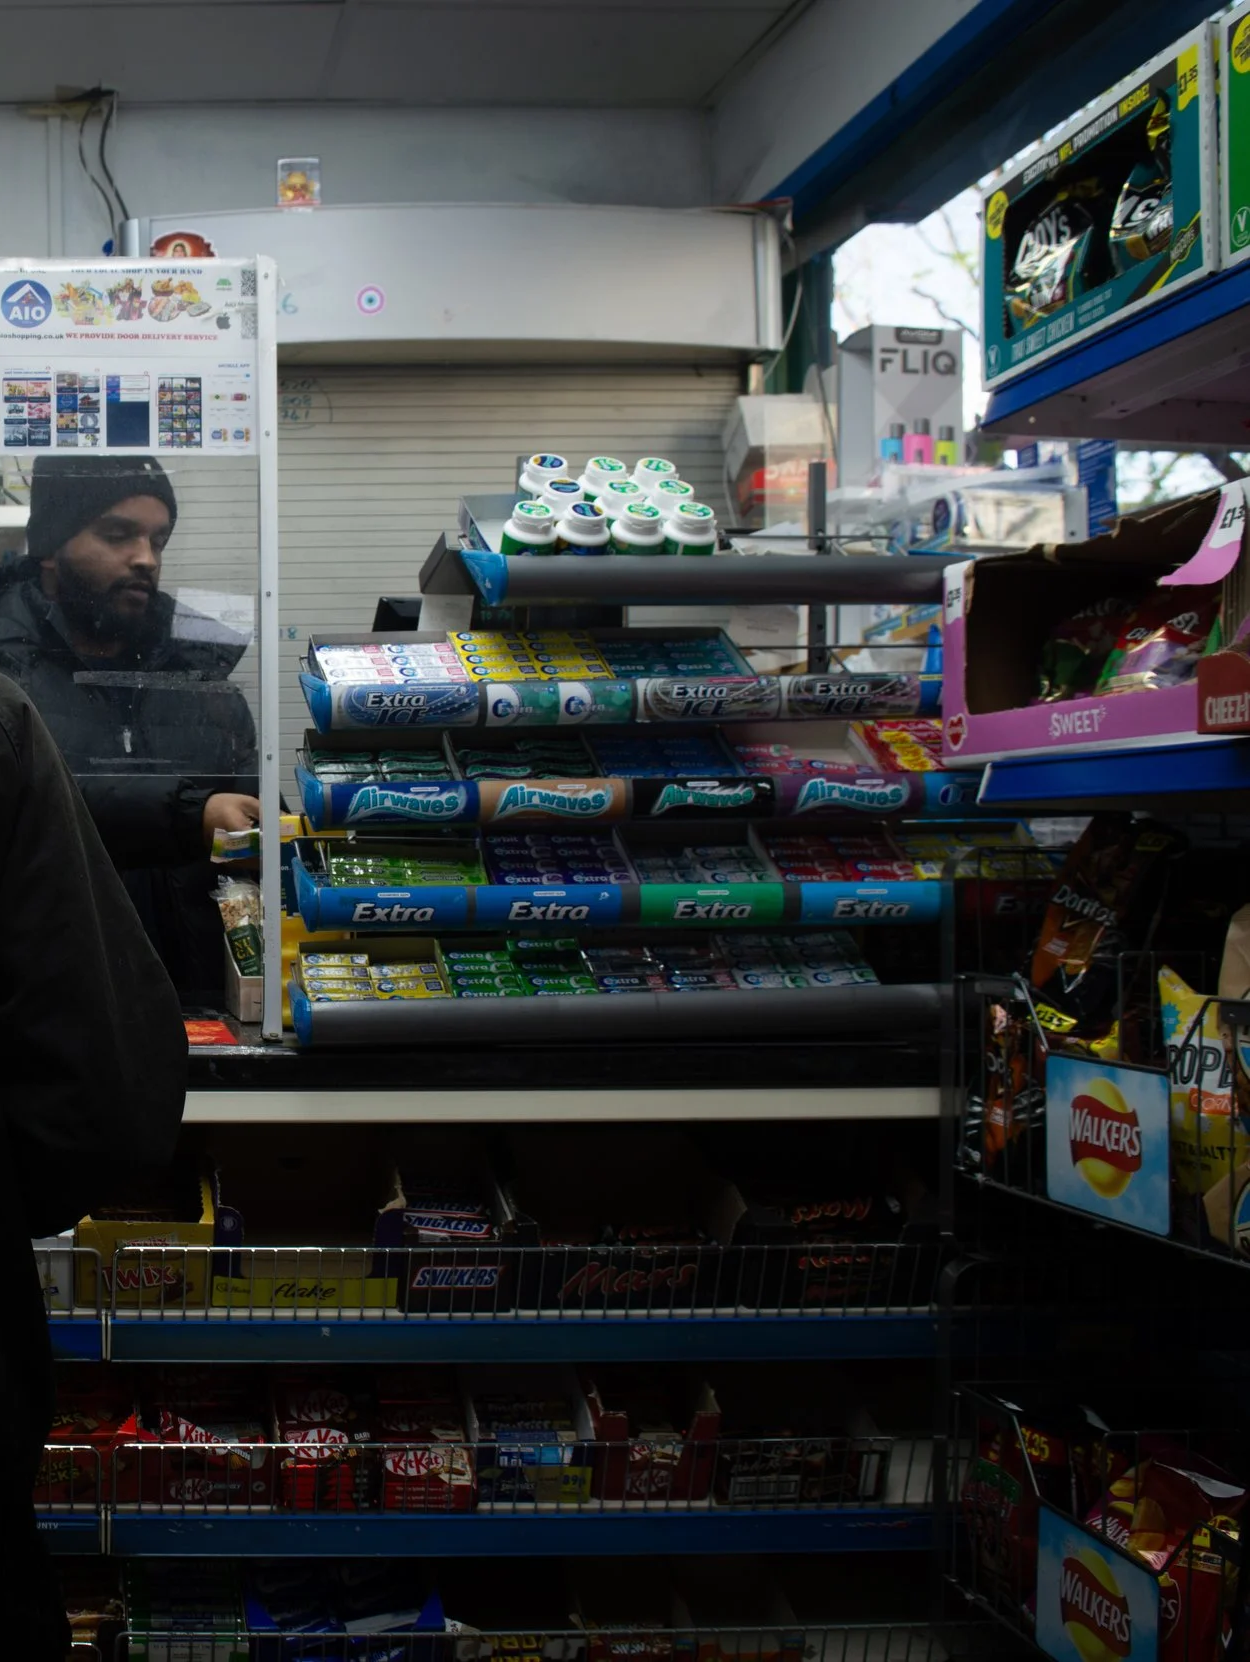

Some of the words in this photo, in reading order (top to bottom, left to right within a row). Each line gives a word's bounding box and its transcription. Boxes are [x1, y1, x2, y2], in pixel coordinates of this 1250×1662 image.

[8, 306, 47, 322] AIO
[65, 332, 77, 340] WE
[79, 332, 116, 340] PROVIDE
[117, 333, 140, 341] DOOR
[141, 333, 183, 341] DELIVERY
[183, 334, 219, 342] SERVICE
[879, 348, 958, 376] FLIQ
[365, 691, 428, 709] Extra
[671, 684, 728, 700] Extra
[373, 705, 430, 726] ICE
[1050, 708, 1102, 738] SWEET
[348, 786, 466, 818] Airwaves
[496, 784, 611, 815] Airwaves
[351, 902, 436, 924] Extra
[507, 900, 591, 922] Extra
[672, 898, 753, 920] Extra
[831, 897, 911, 919] Extra
[1052, 883, 1119, 929] Doritos
[1069, 1107, 1143, 1158] WALKERS
[415, 1266, 500, 1287] SNICKERS
[390, 1452, 441, 1476] KitKat
[1060, 1570, 1132, 1644] WALKERS
